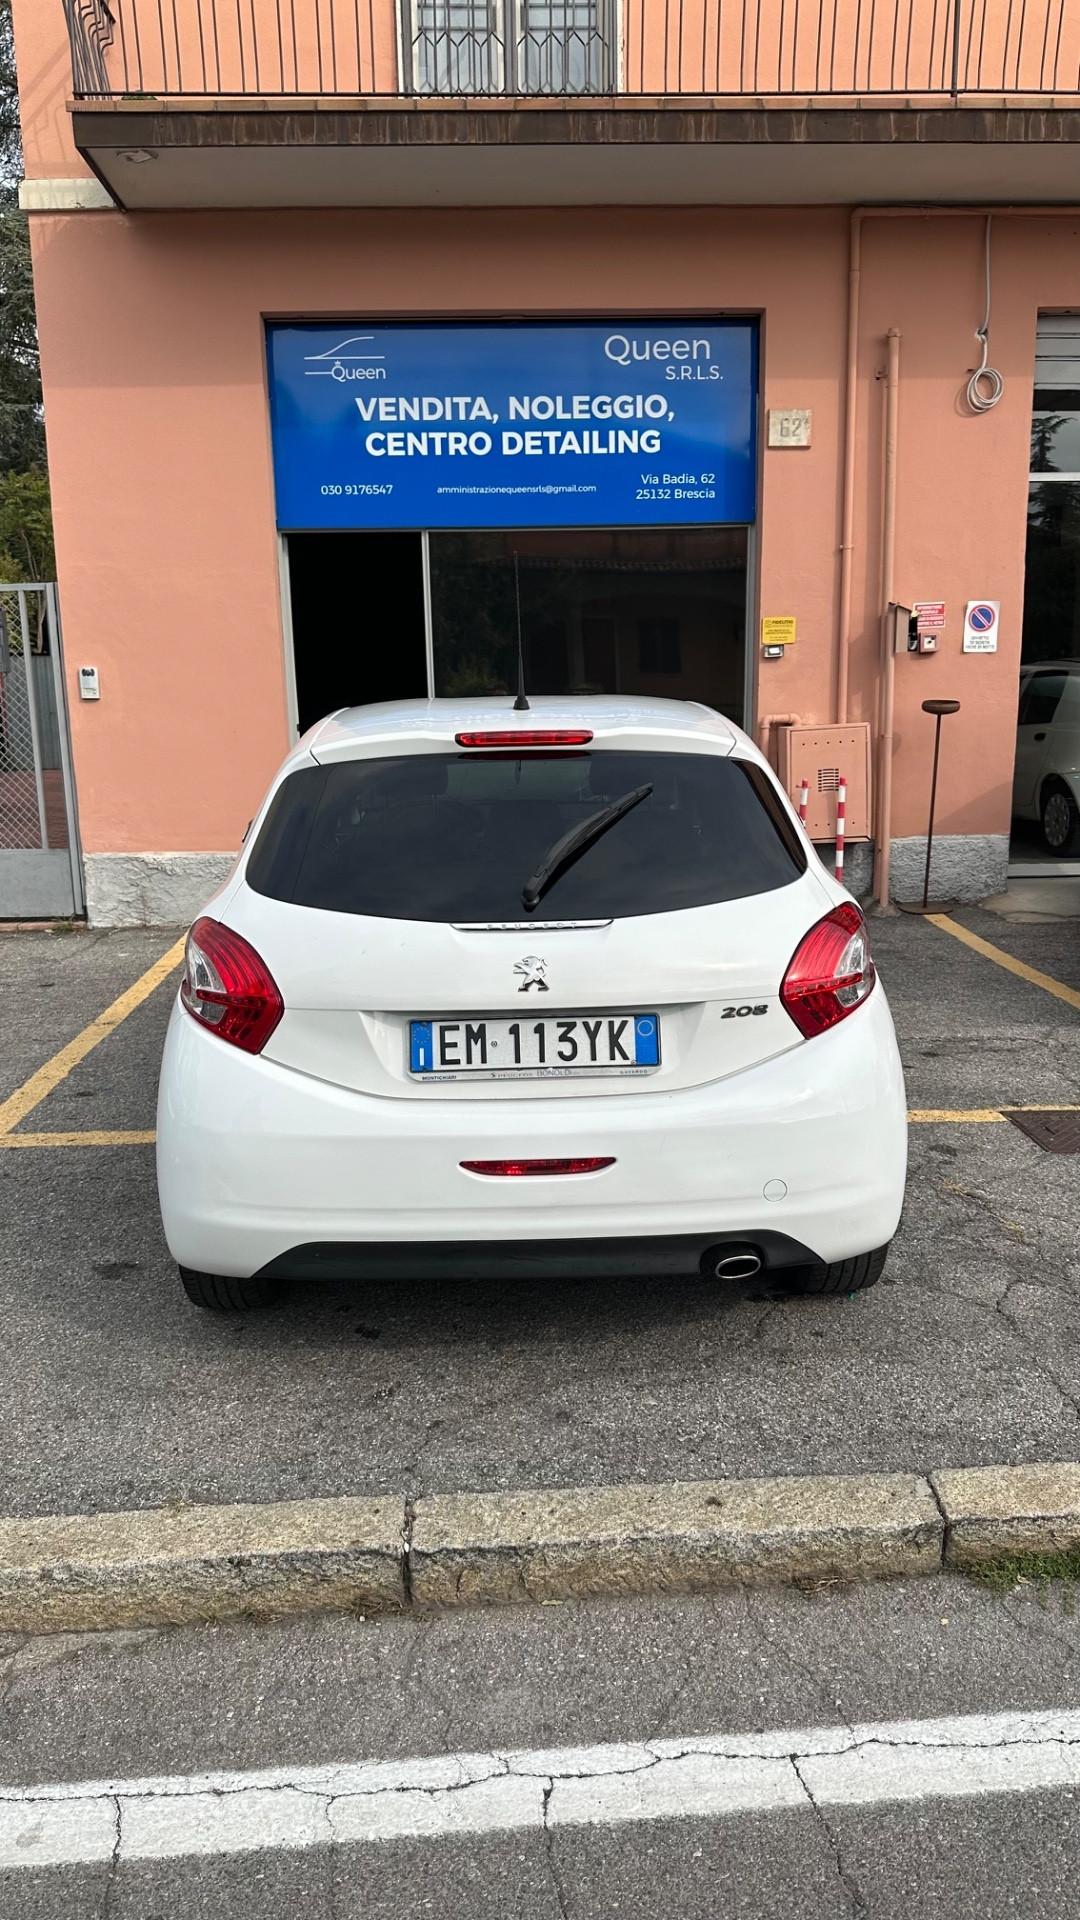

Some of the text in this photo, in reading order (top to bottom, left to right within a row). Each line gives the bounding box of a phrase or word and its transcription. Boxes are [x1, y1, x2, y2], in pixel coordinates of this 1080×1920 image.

[604, 334, 711, 366] Queen
[331, 365, 386, 382] Queen
[664, 364, 724, 381] S.R.L.S.
[355, 394, 675, 425] VENDITA, NOLEGGIO,
[365, 429, 661, 457] CENTRO DETAILING
[640, 472, 717, 485] Via Badia, 62
[320, 484, 394, 496] 030 9176547
[436, 484, 597, 495] amministrazionequeensrls@gmail.com
[635, 487, 716, 500] 25132 Brescia
[720, 1004, 769, 1019] 208
[439, 1019, 631, 1066] EM 113YK
